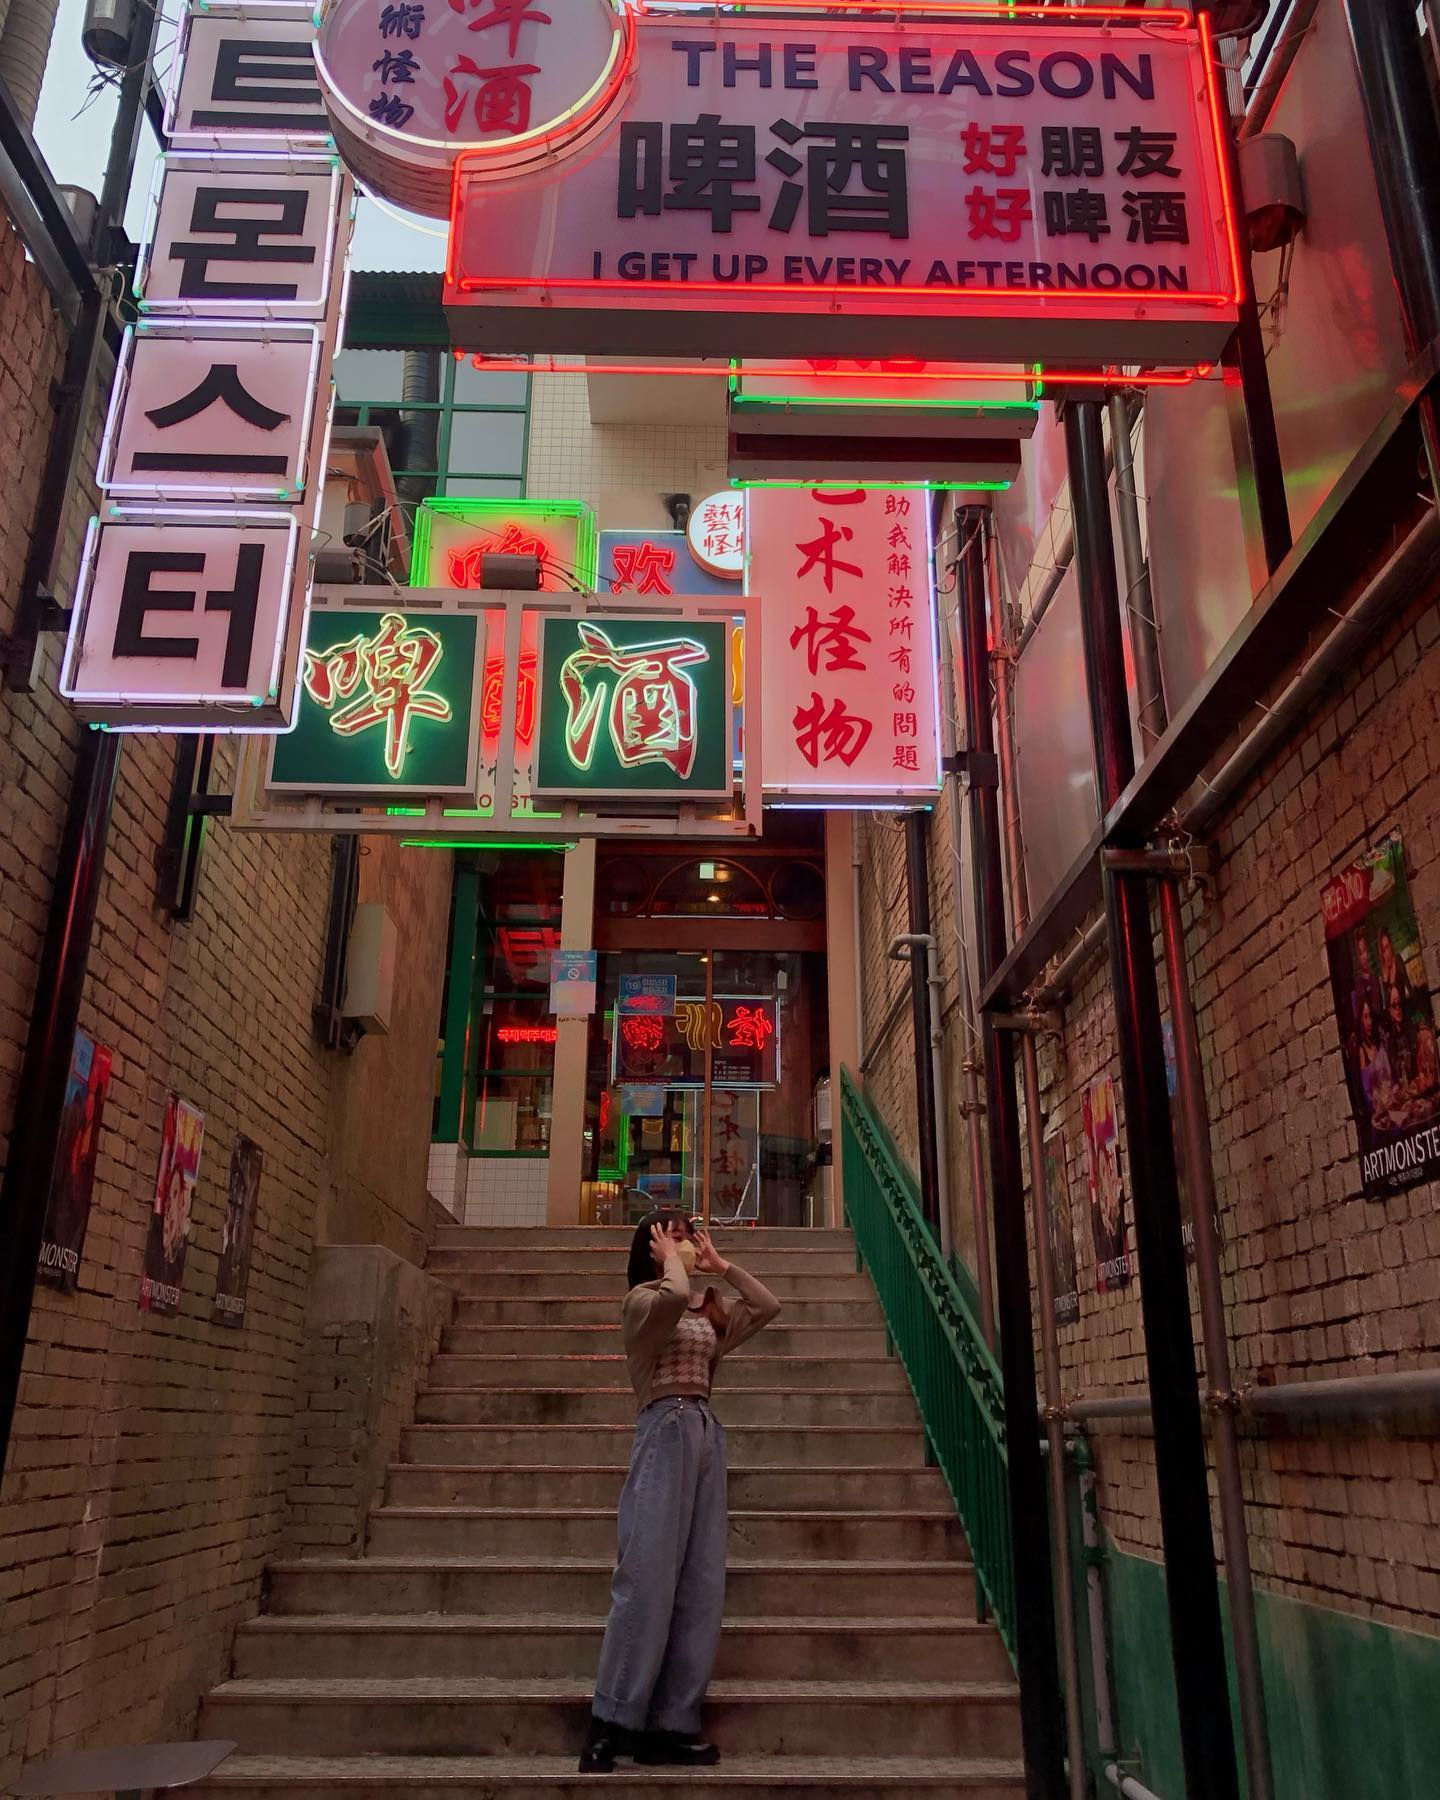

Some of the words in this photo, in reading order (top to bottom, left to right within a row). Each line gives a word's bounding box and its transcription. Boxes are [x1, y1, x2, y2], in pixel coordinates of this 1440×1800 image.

[671, 40, 819, 89] THE
[847, 45, 1155, 101] REASON
[617, 113, 910, 240] 啤酒
[960, 121, 1182, 180] 好朋友
[964, 185, 1190, 246] 好啤酒
[592, 251, 602, 280] I
[617, 251, 697, 282] GET
[712, 253, 768, 284] UP
[783, 256, 911, 287] EVERY
[924, 259, 1189, 292] AFTERNOON
[884, 480, 921, 772] 助我解決所有的問題
[1363, 1125, 1440, 1183] ARTMONSTE
[38, 1241, 79, 1274] MONSTER
